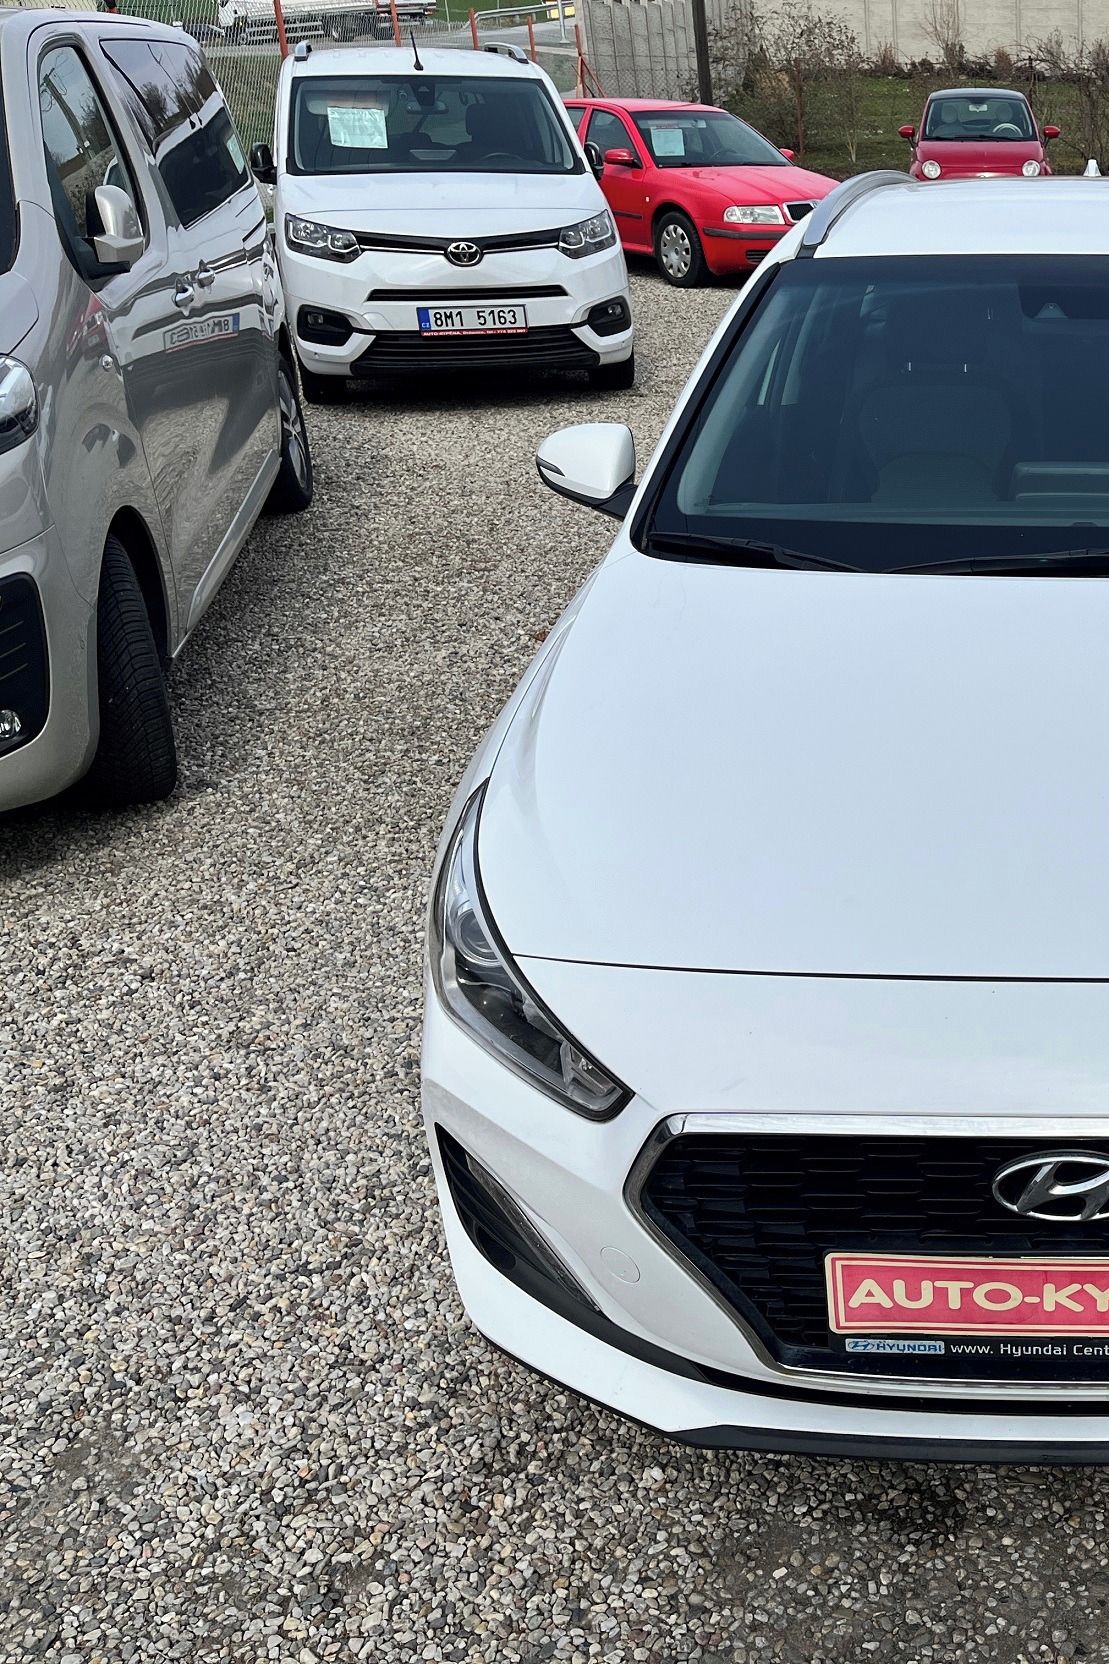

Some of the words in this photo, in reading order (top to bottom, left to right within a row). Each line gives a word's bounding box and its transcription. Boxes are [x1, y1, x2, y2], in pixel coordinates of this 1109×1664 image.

[433, 311, 464, 327] 8M1
[476, 309, 517, 327] 5163
[876, 1341, 942, 1353] HYUNDAI
[950, 1344, 994, 1354] www.
[1000, 1343, 1067, 1356] Hyundai
